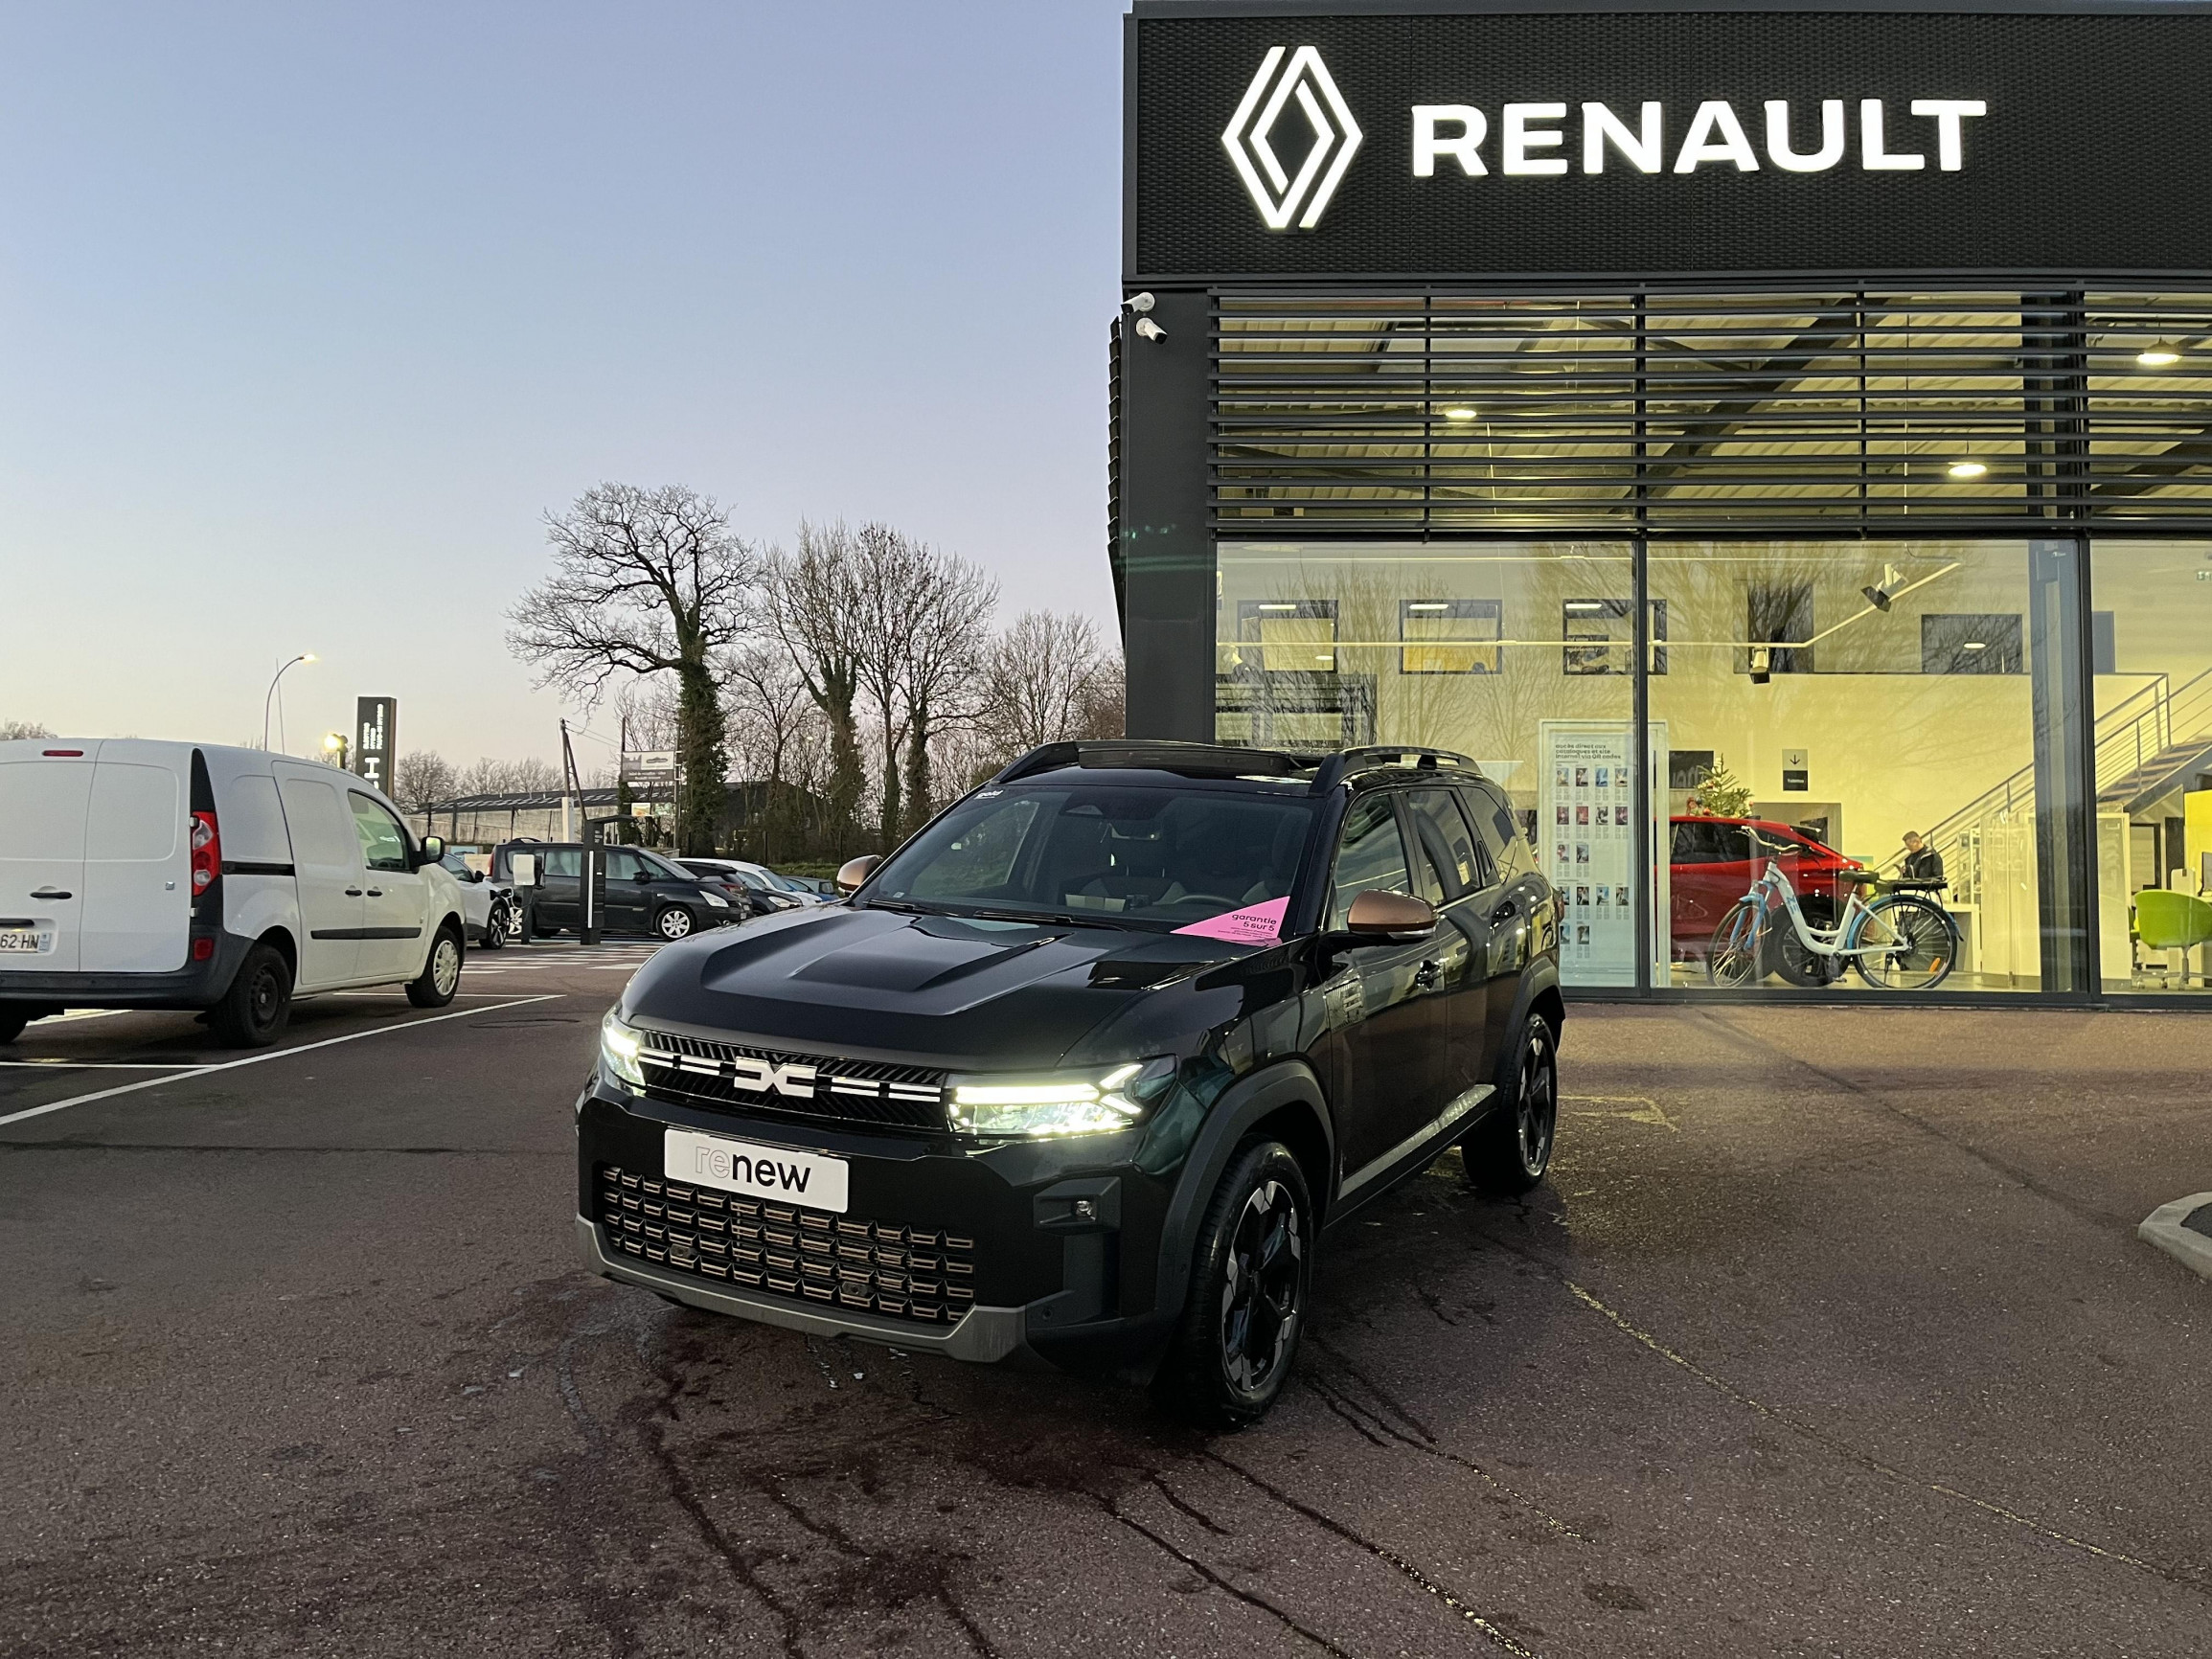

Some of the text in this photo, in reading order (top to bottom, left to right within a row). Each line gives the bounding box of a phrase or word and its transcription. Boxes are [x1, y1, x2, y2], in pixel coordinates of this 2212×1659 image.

[1411, 99, 1987, 177] RENAULT
[1232, 914, 1277, 925] garantie
[695, 1146, 811, 1193] renew
